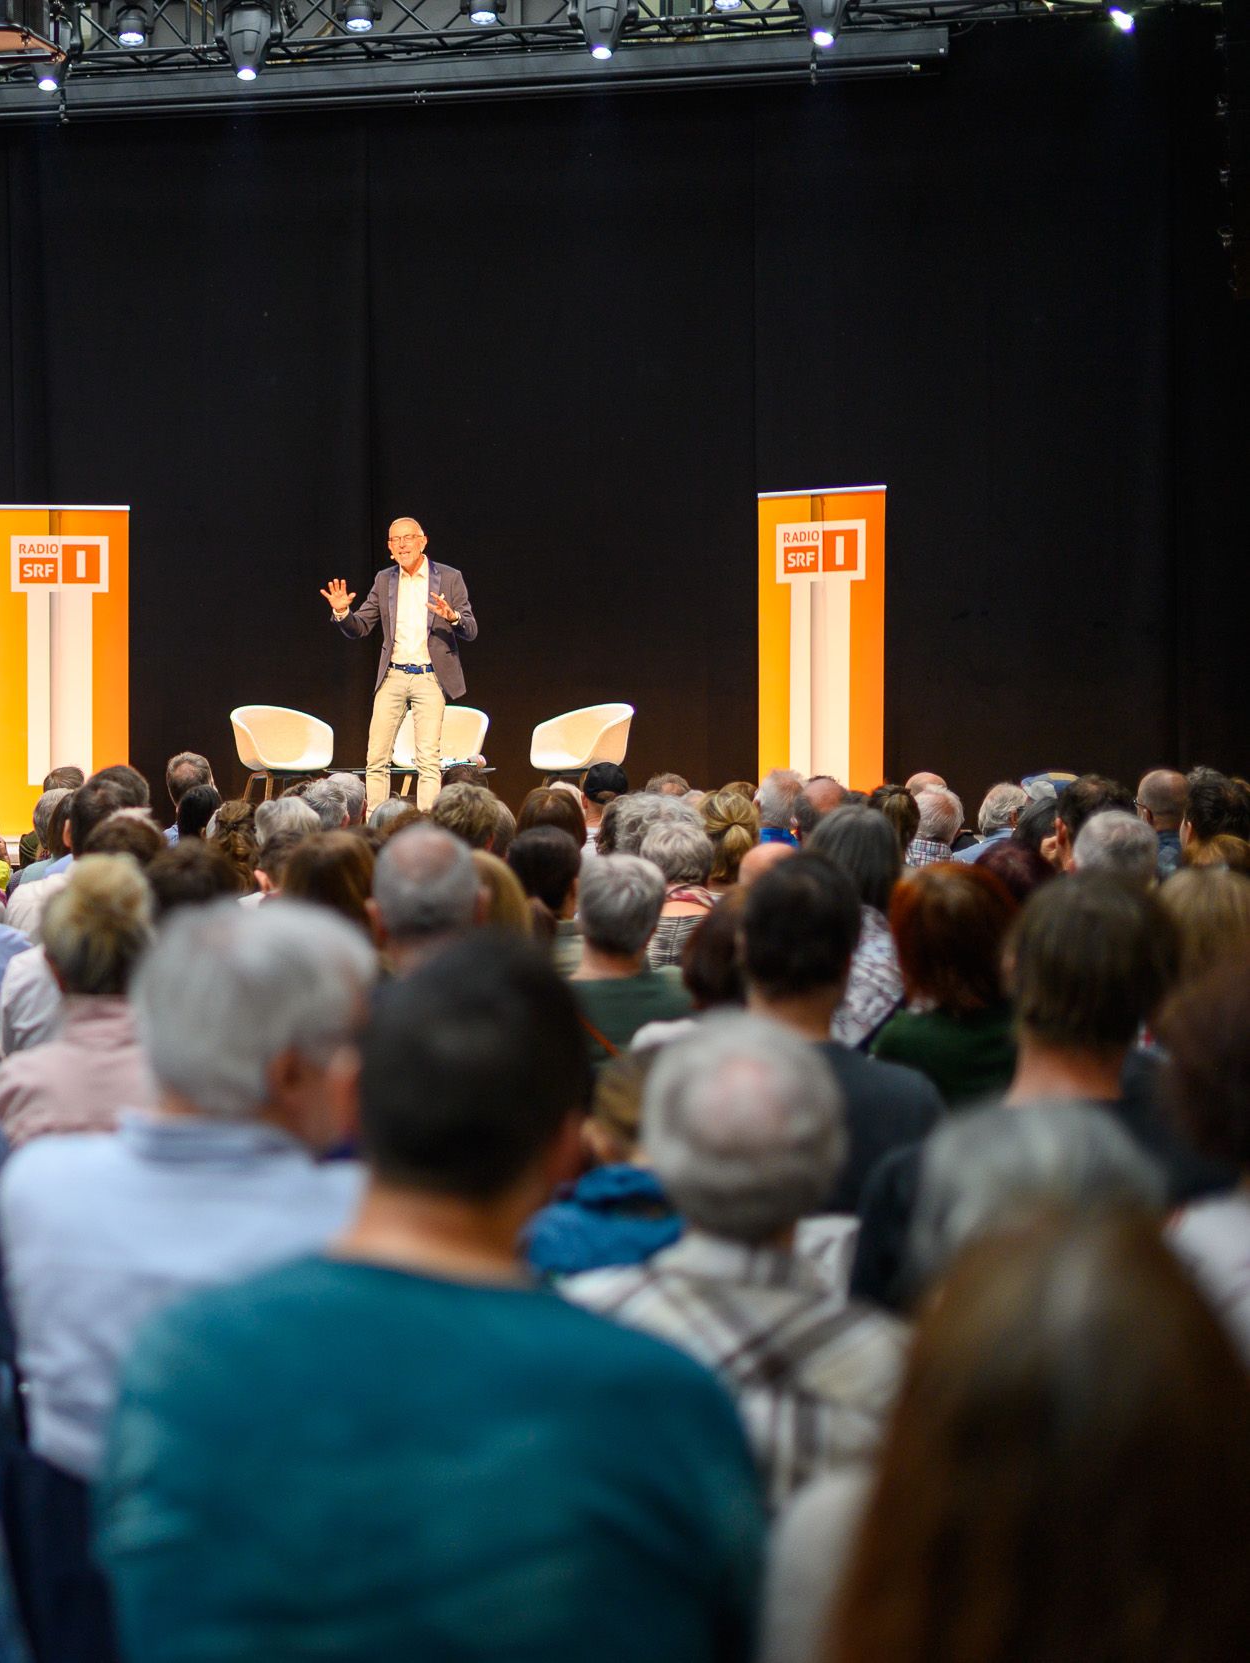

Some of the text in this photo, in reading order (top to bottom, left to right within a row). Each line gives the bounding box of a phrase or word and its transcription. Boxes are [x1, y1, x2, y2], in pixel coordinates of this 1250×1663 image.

[783, 530, 820, 543] RADIO
[18, 543, 59, 554] RADIO
[787, 551, 816, 568] SRF
[22, 563, 55, 578] SRF
